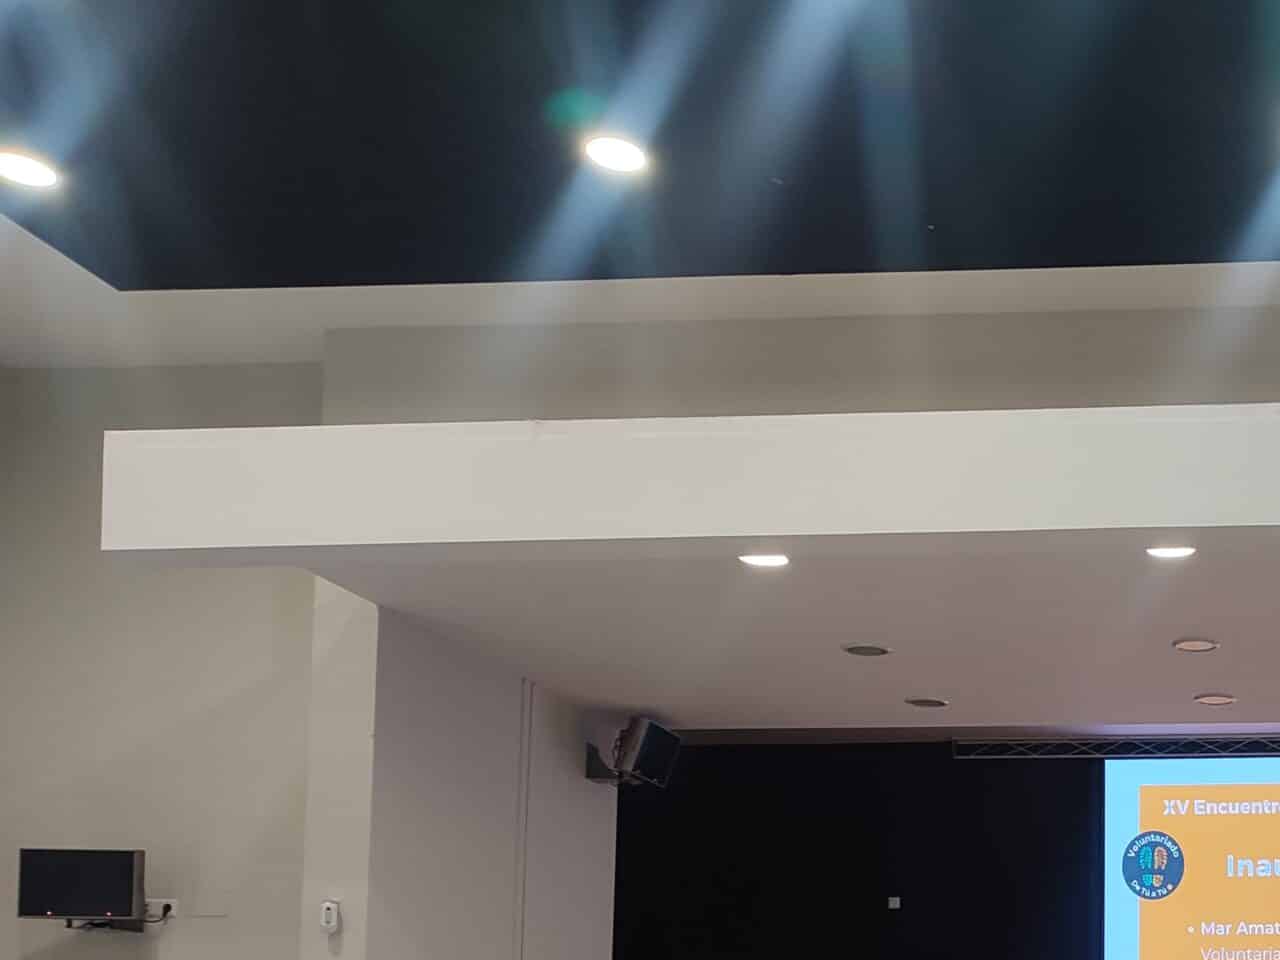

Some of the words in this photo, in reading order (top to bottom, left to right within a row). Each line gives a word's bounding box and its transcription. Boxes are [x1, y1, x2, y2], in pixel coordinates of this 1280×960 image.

[1163, 799, 1188, 816] XV
[1127, 834, 1180, 858] Voluntariado
[1201, 922, 1232, 936] Mar
